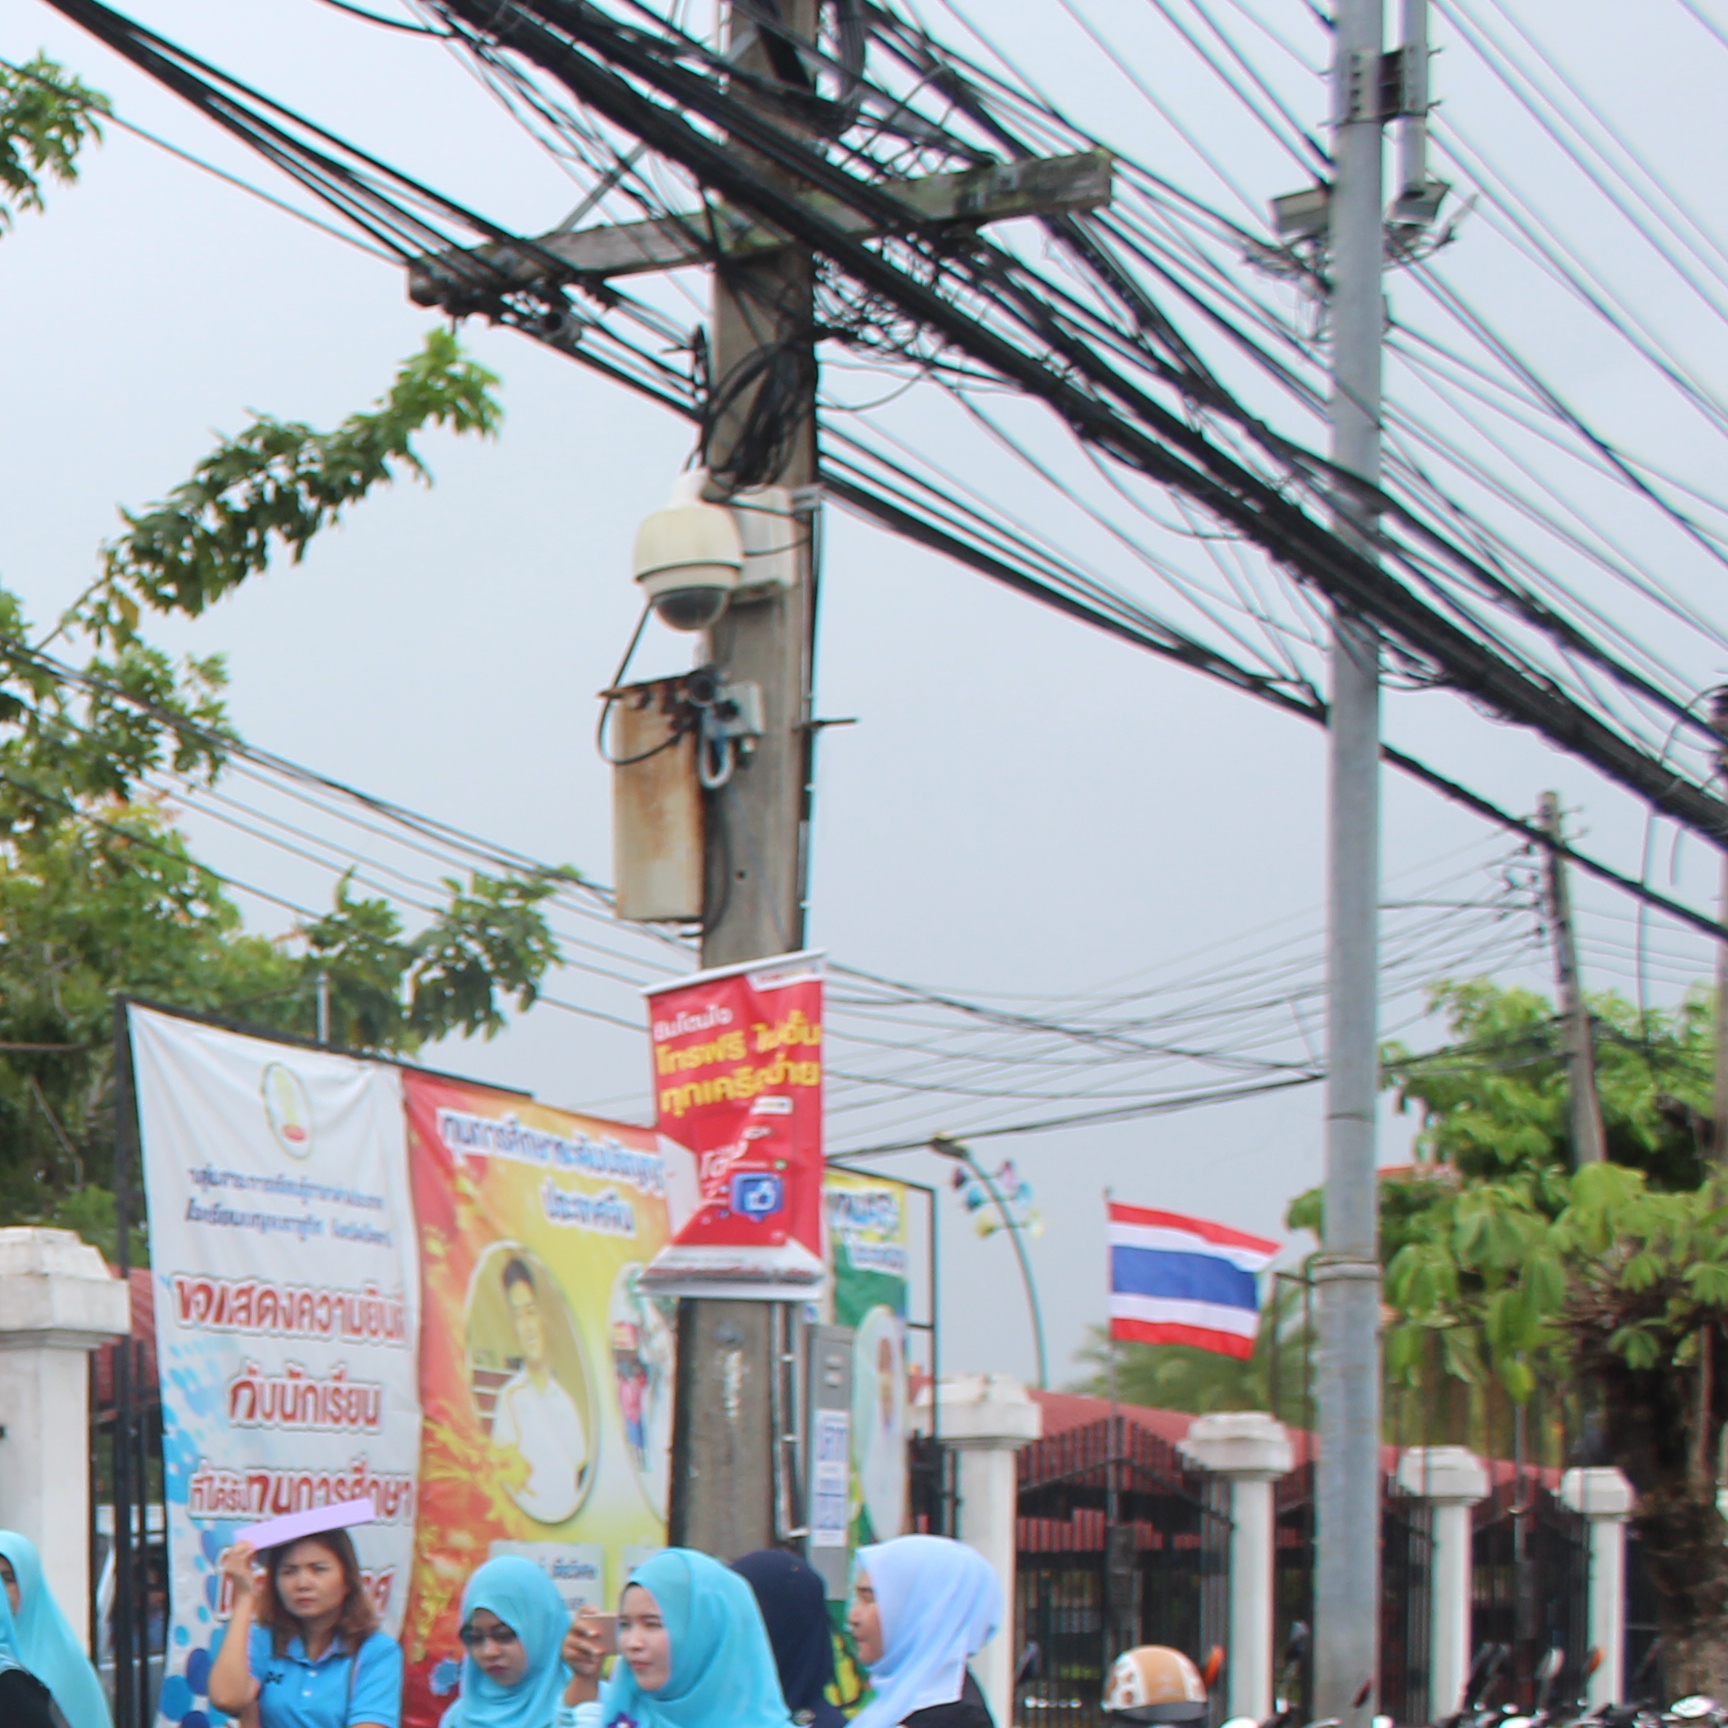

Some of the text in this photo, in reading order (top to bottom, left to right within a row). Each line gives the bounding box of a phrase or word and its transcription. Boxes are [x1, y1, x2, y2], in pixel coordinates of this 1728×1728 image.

[226, 1362, 383, 1430] กับนักเรียน
